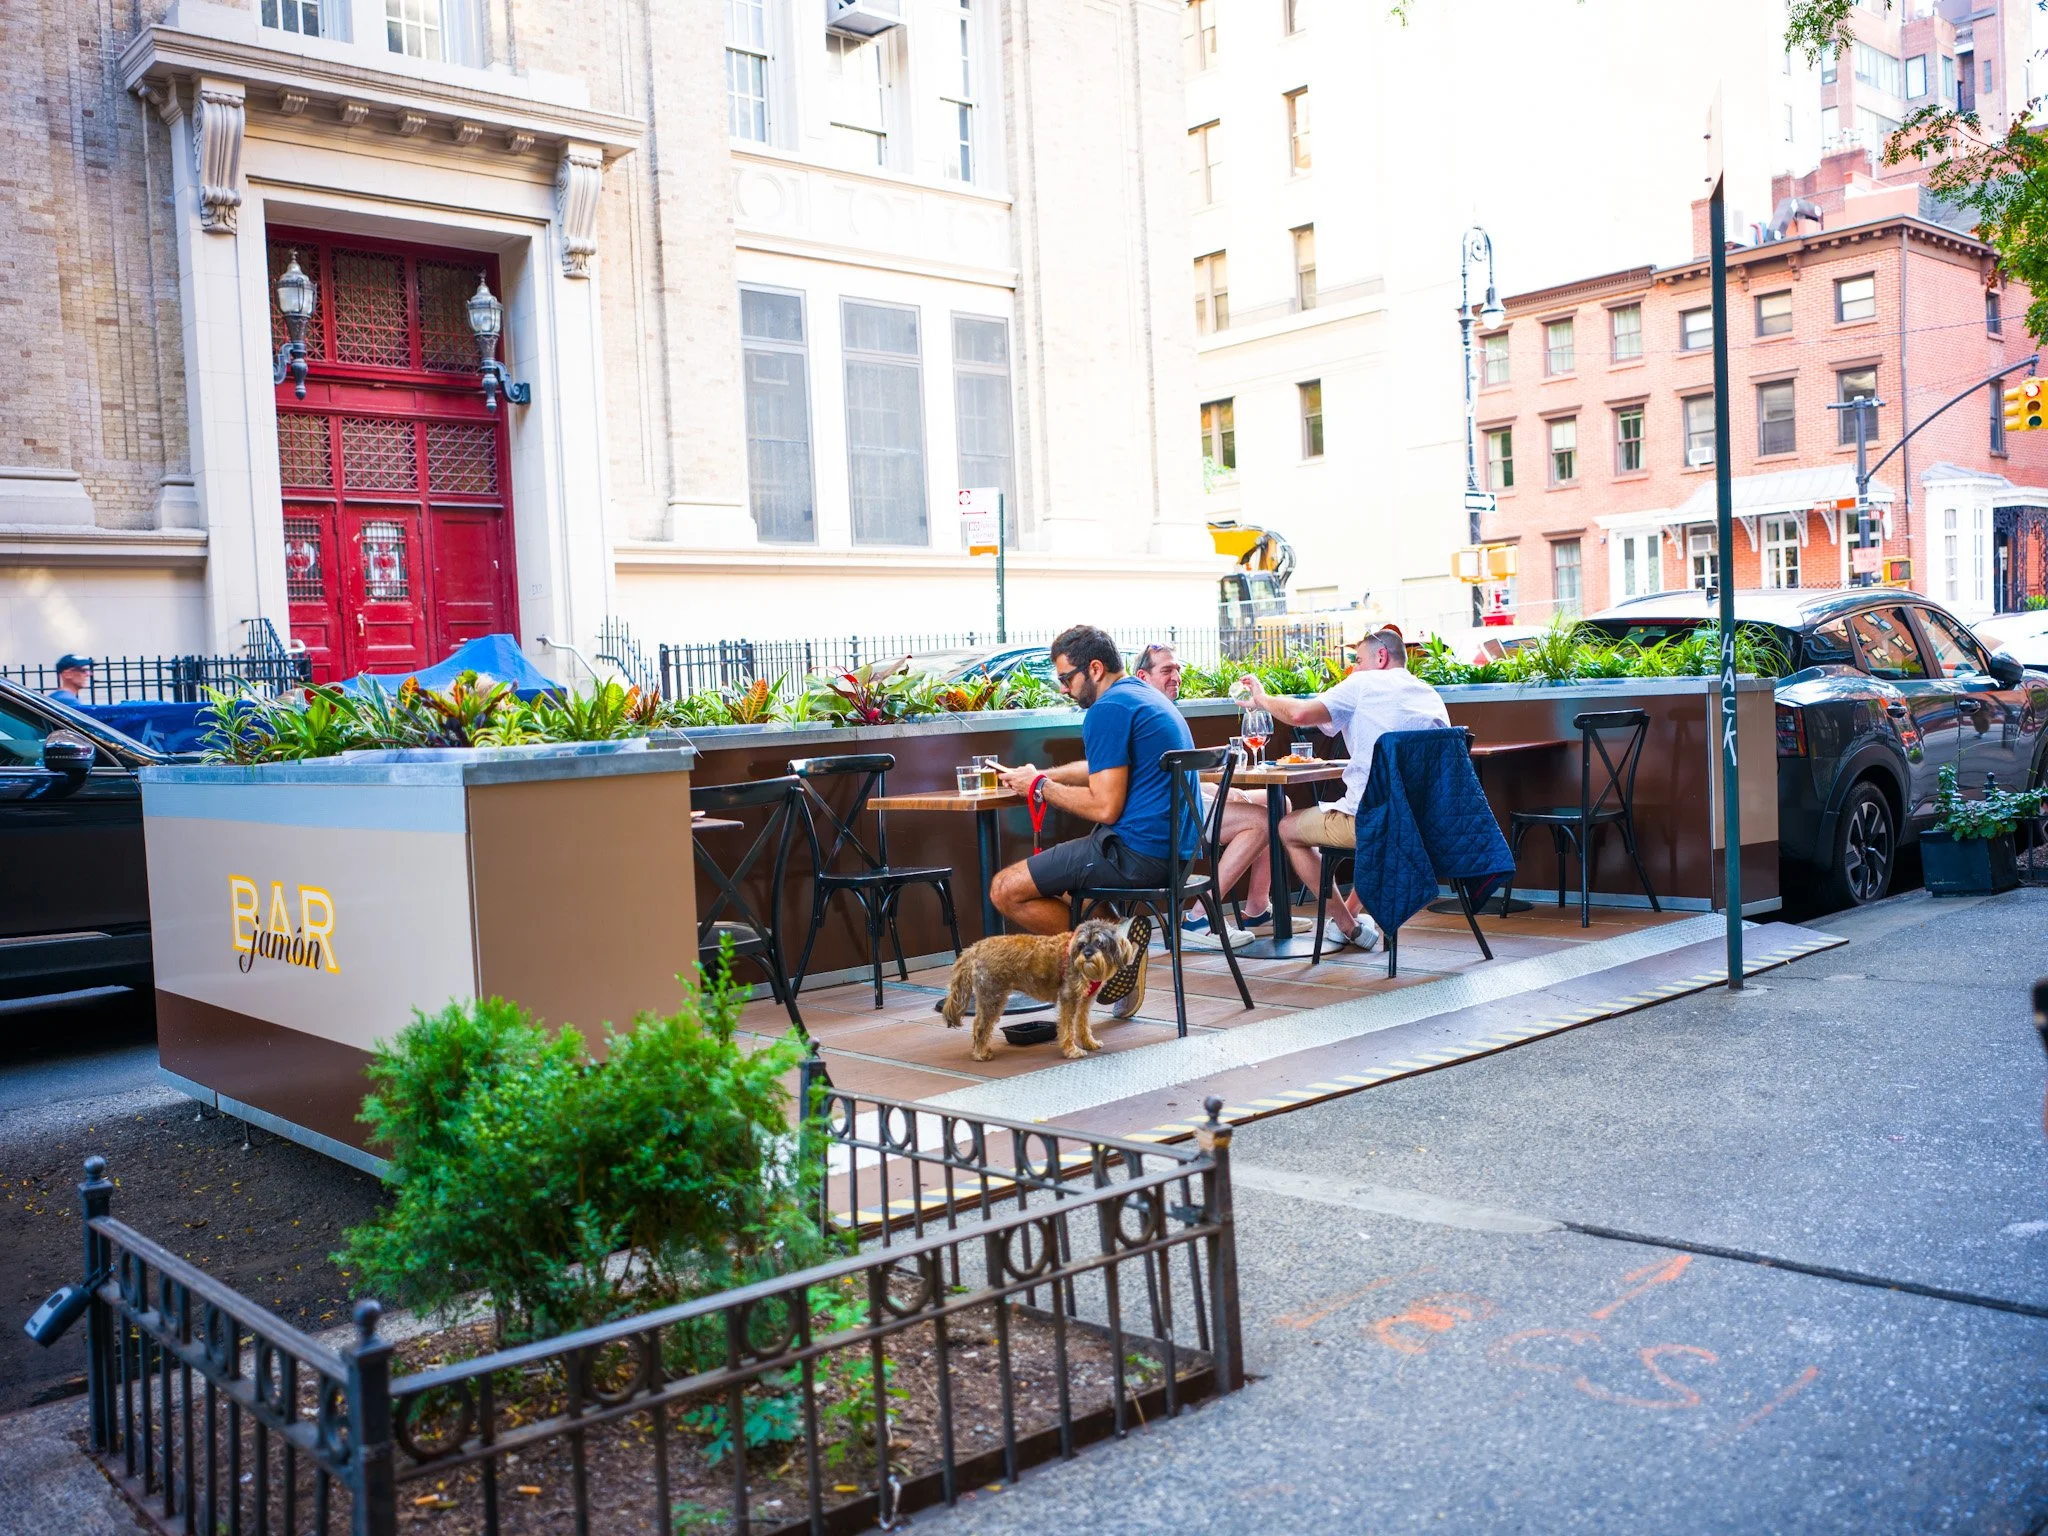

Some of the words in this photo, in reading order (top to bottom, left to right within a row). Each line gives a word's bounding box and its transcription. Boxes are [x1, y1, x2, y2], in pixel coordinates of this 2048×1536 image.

[1721, 632, 1738, 767] HACK
[228, 873, 341, 976] BAR
[239, 915, 324, 974] jamón
